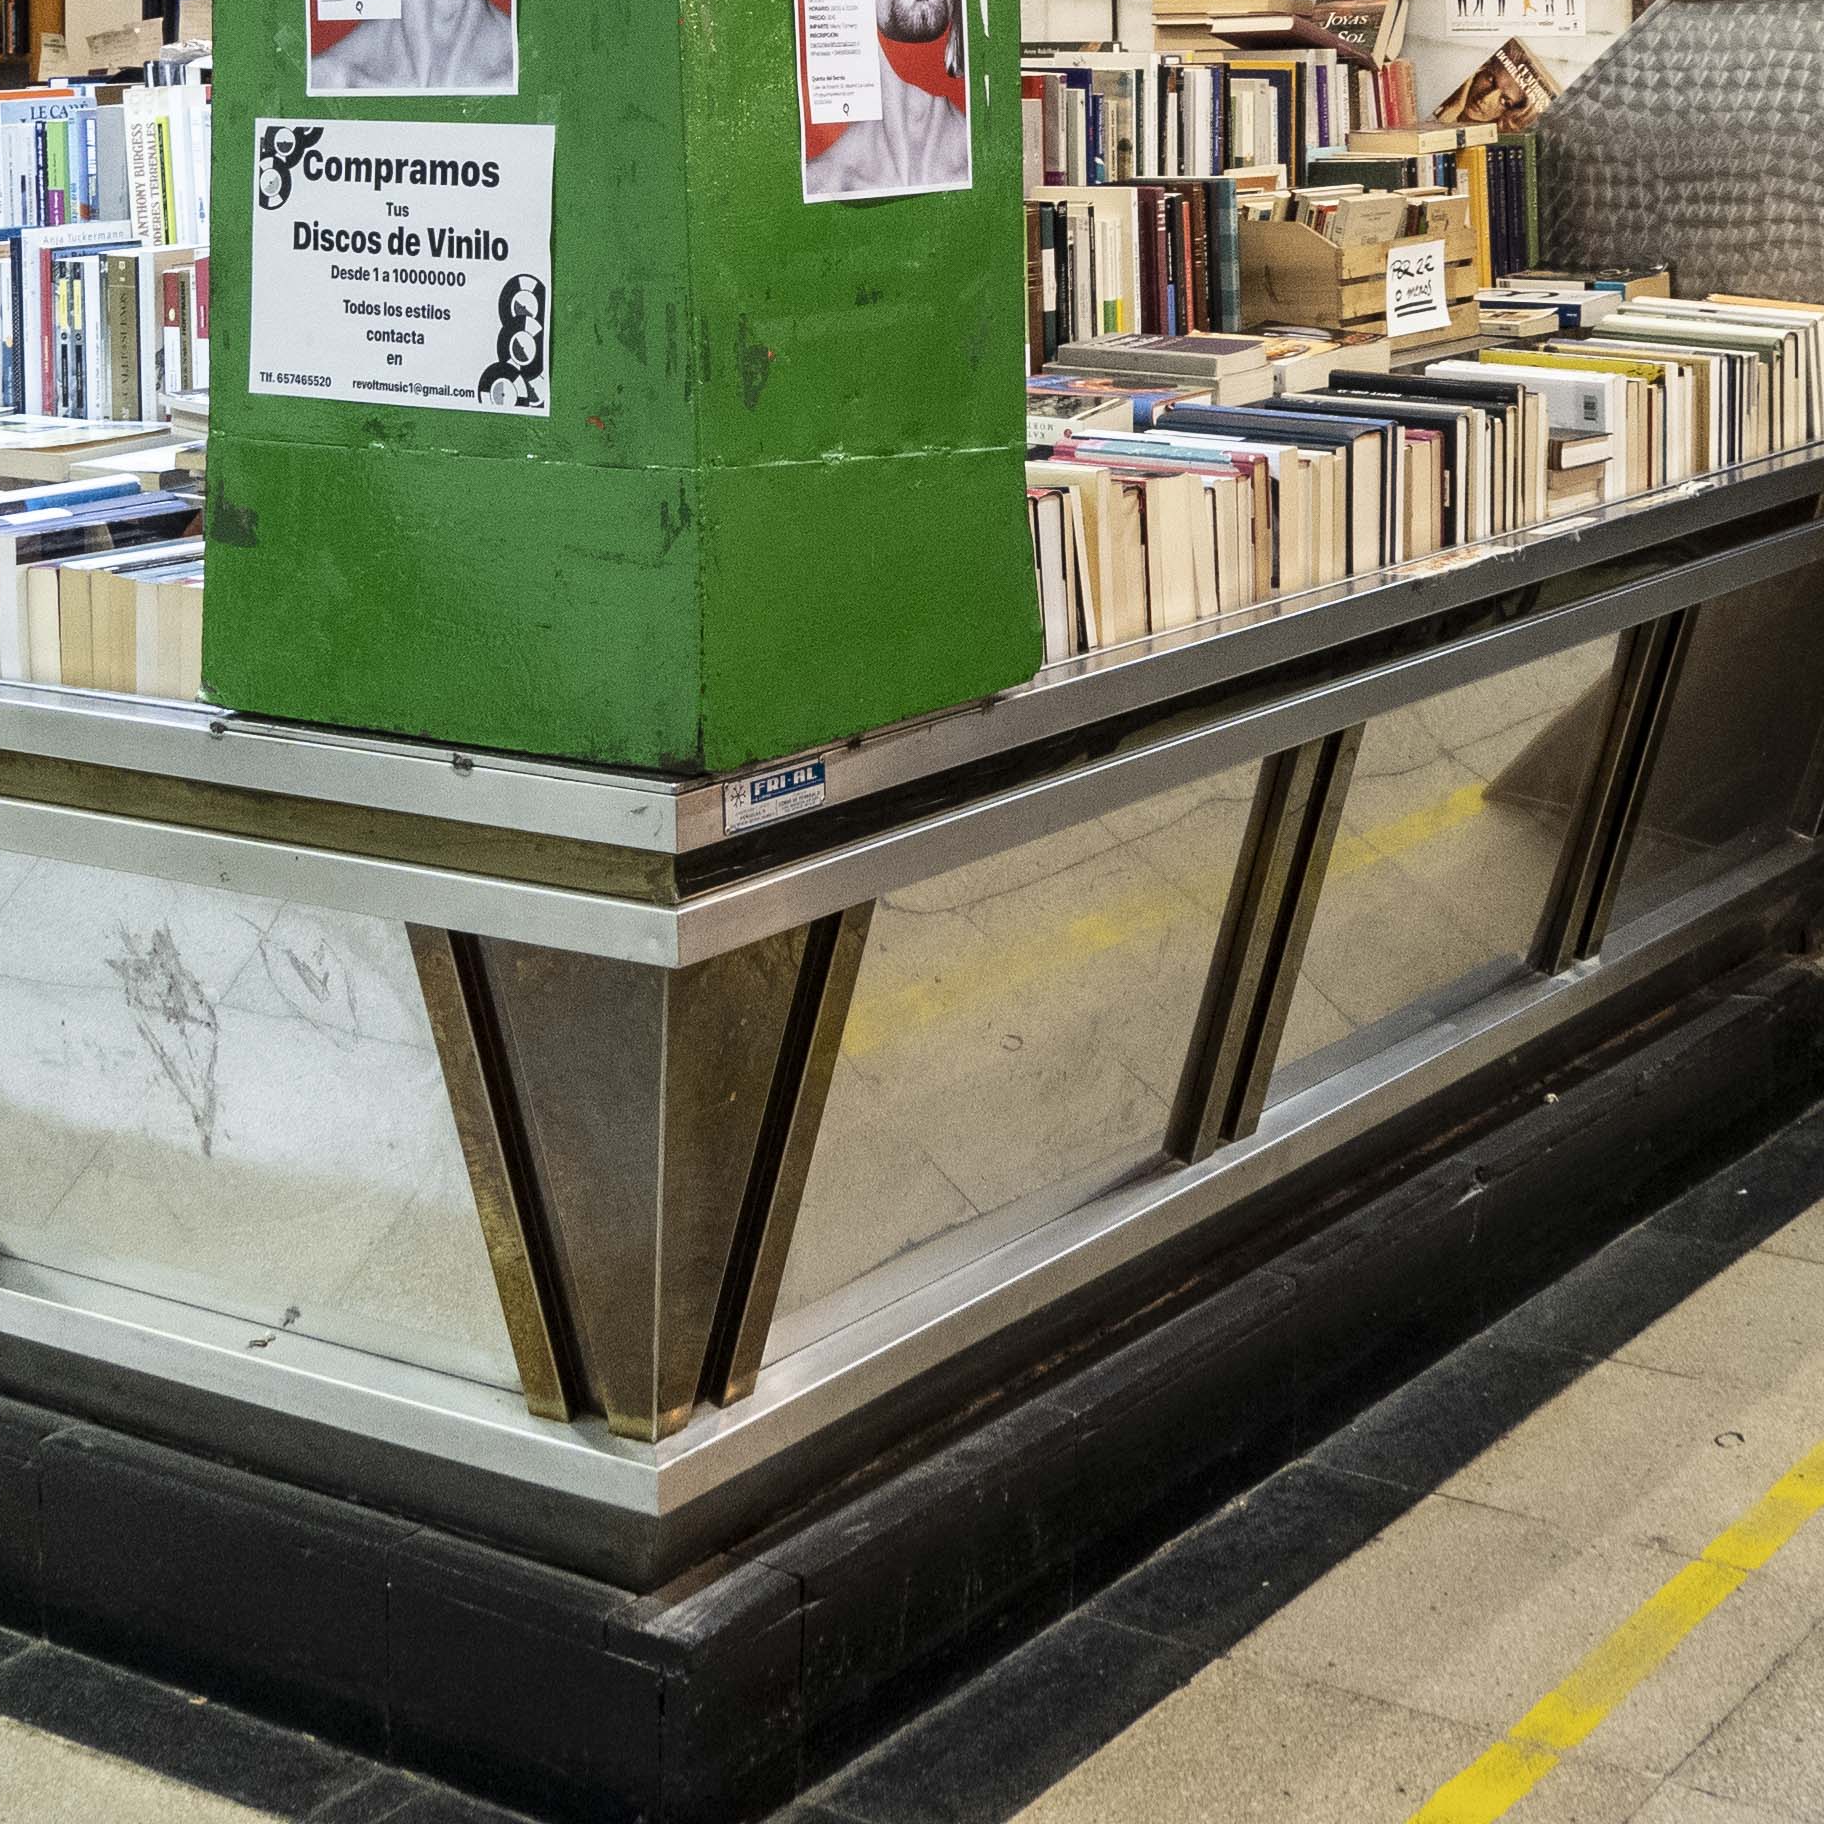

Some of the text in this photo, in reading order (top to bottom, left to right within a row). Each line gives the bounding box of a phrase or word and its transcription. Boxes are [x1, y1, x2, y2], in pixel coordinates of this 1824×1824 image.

[1325, 12, 1368, 29] JOYAS
[1338, 30, 1366, 44] SOL
[31, 106, 47, 120] LE
[303, 149, 500, 191] Compramos
[130, 123, 151, 237] ANTHONY BURGESS
[144, 122, 164, 247] ODERES TERRENALES
[385, 202, 409, 217] Tus
[293, 221, 509, 262] Discos de Vinilo
[331, 265, 370, 281] Desde
[393, 268, 466, 287] 10000000
[343, 299, 451, 321] Todos los estilos
[366, 329, 425, 345] contacta
[387, 352, 403, 366] en
[260, 371, 332, 387] Tlf. 657465520
[352, 379, 475, 399] revoltmusic1@gmail.com
